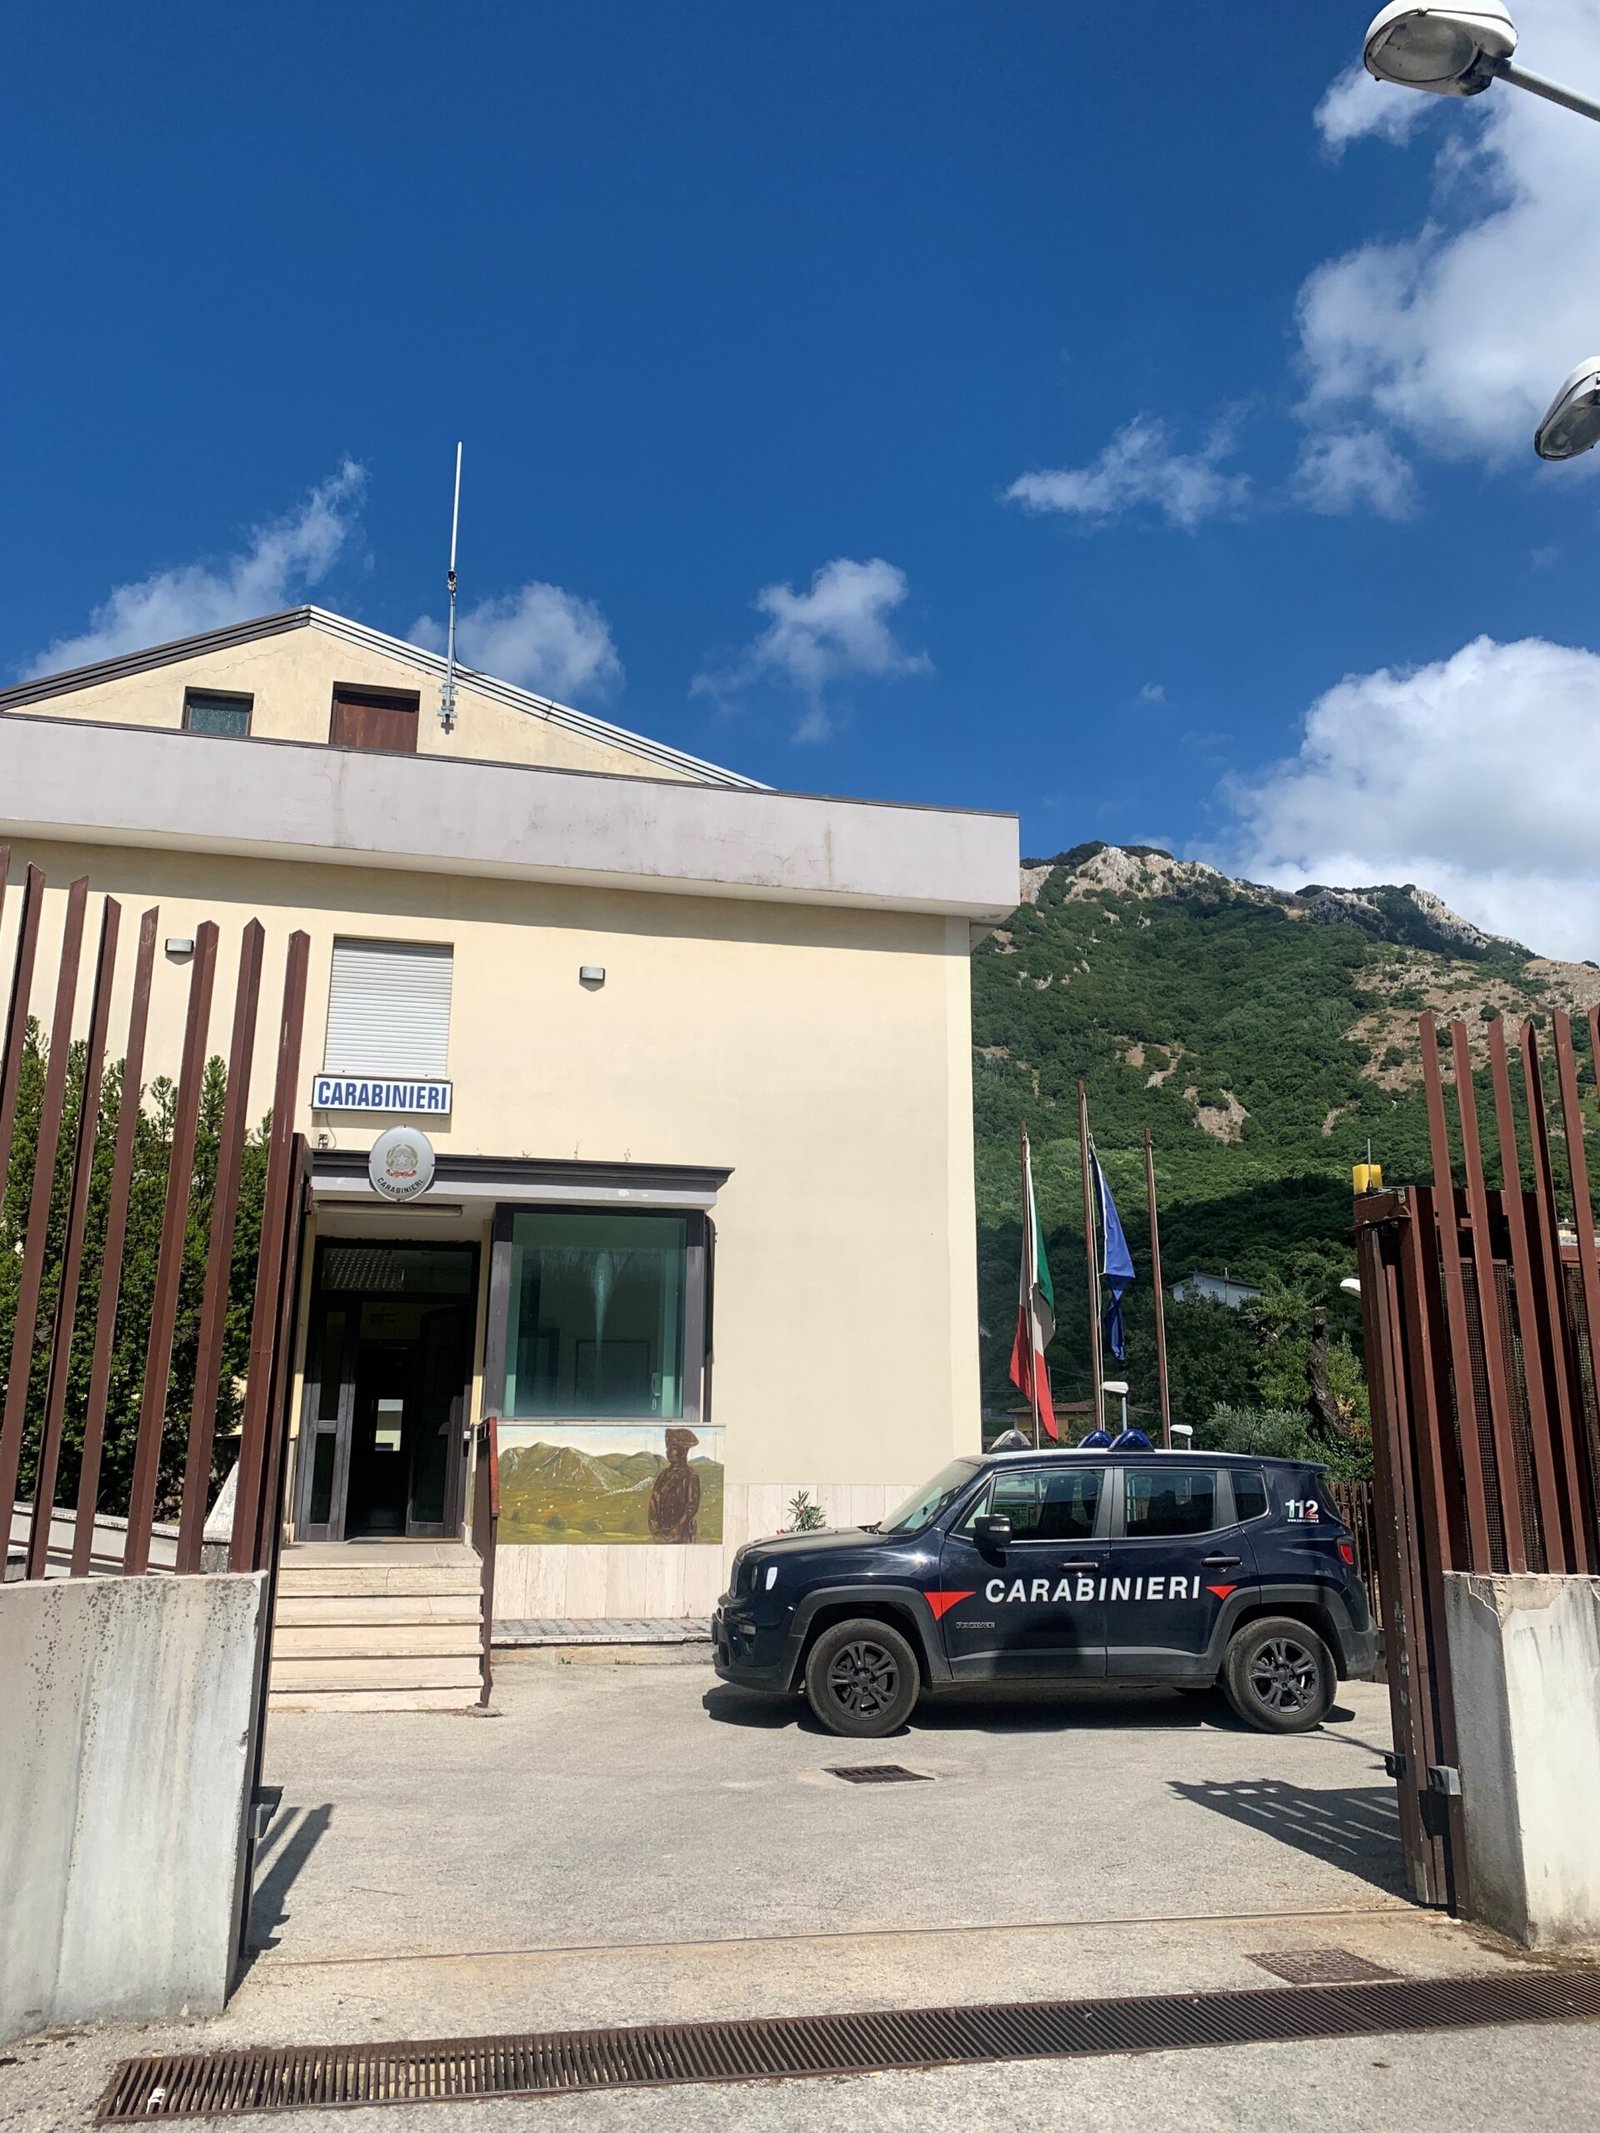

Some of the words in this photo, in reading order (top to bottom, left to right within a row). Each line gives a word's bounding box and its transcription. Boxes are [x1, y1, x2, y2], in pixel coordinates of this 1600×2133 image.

[318, 1081, 447, 1110] CARABINIERI
[377, 1177, 424, 1195] CARABINIERI
[1284, 1499, 1319, 1519] 112
[985, 1575, 1201, 1604] CARABINIERI
